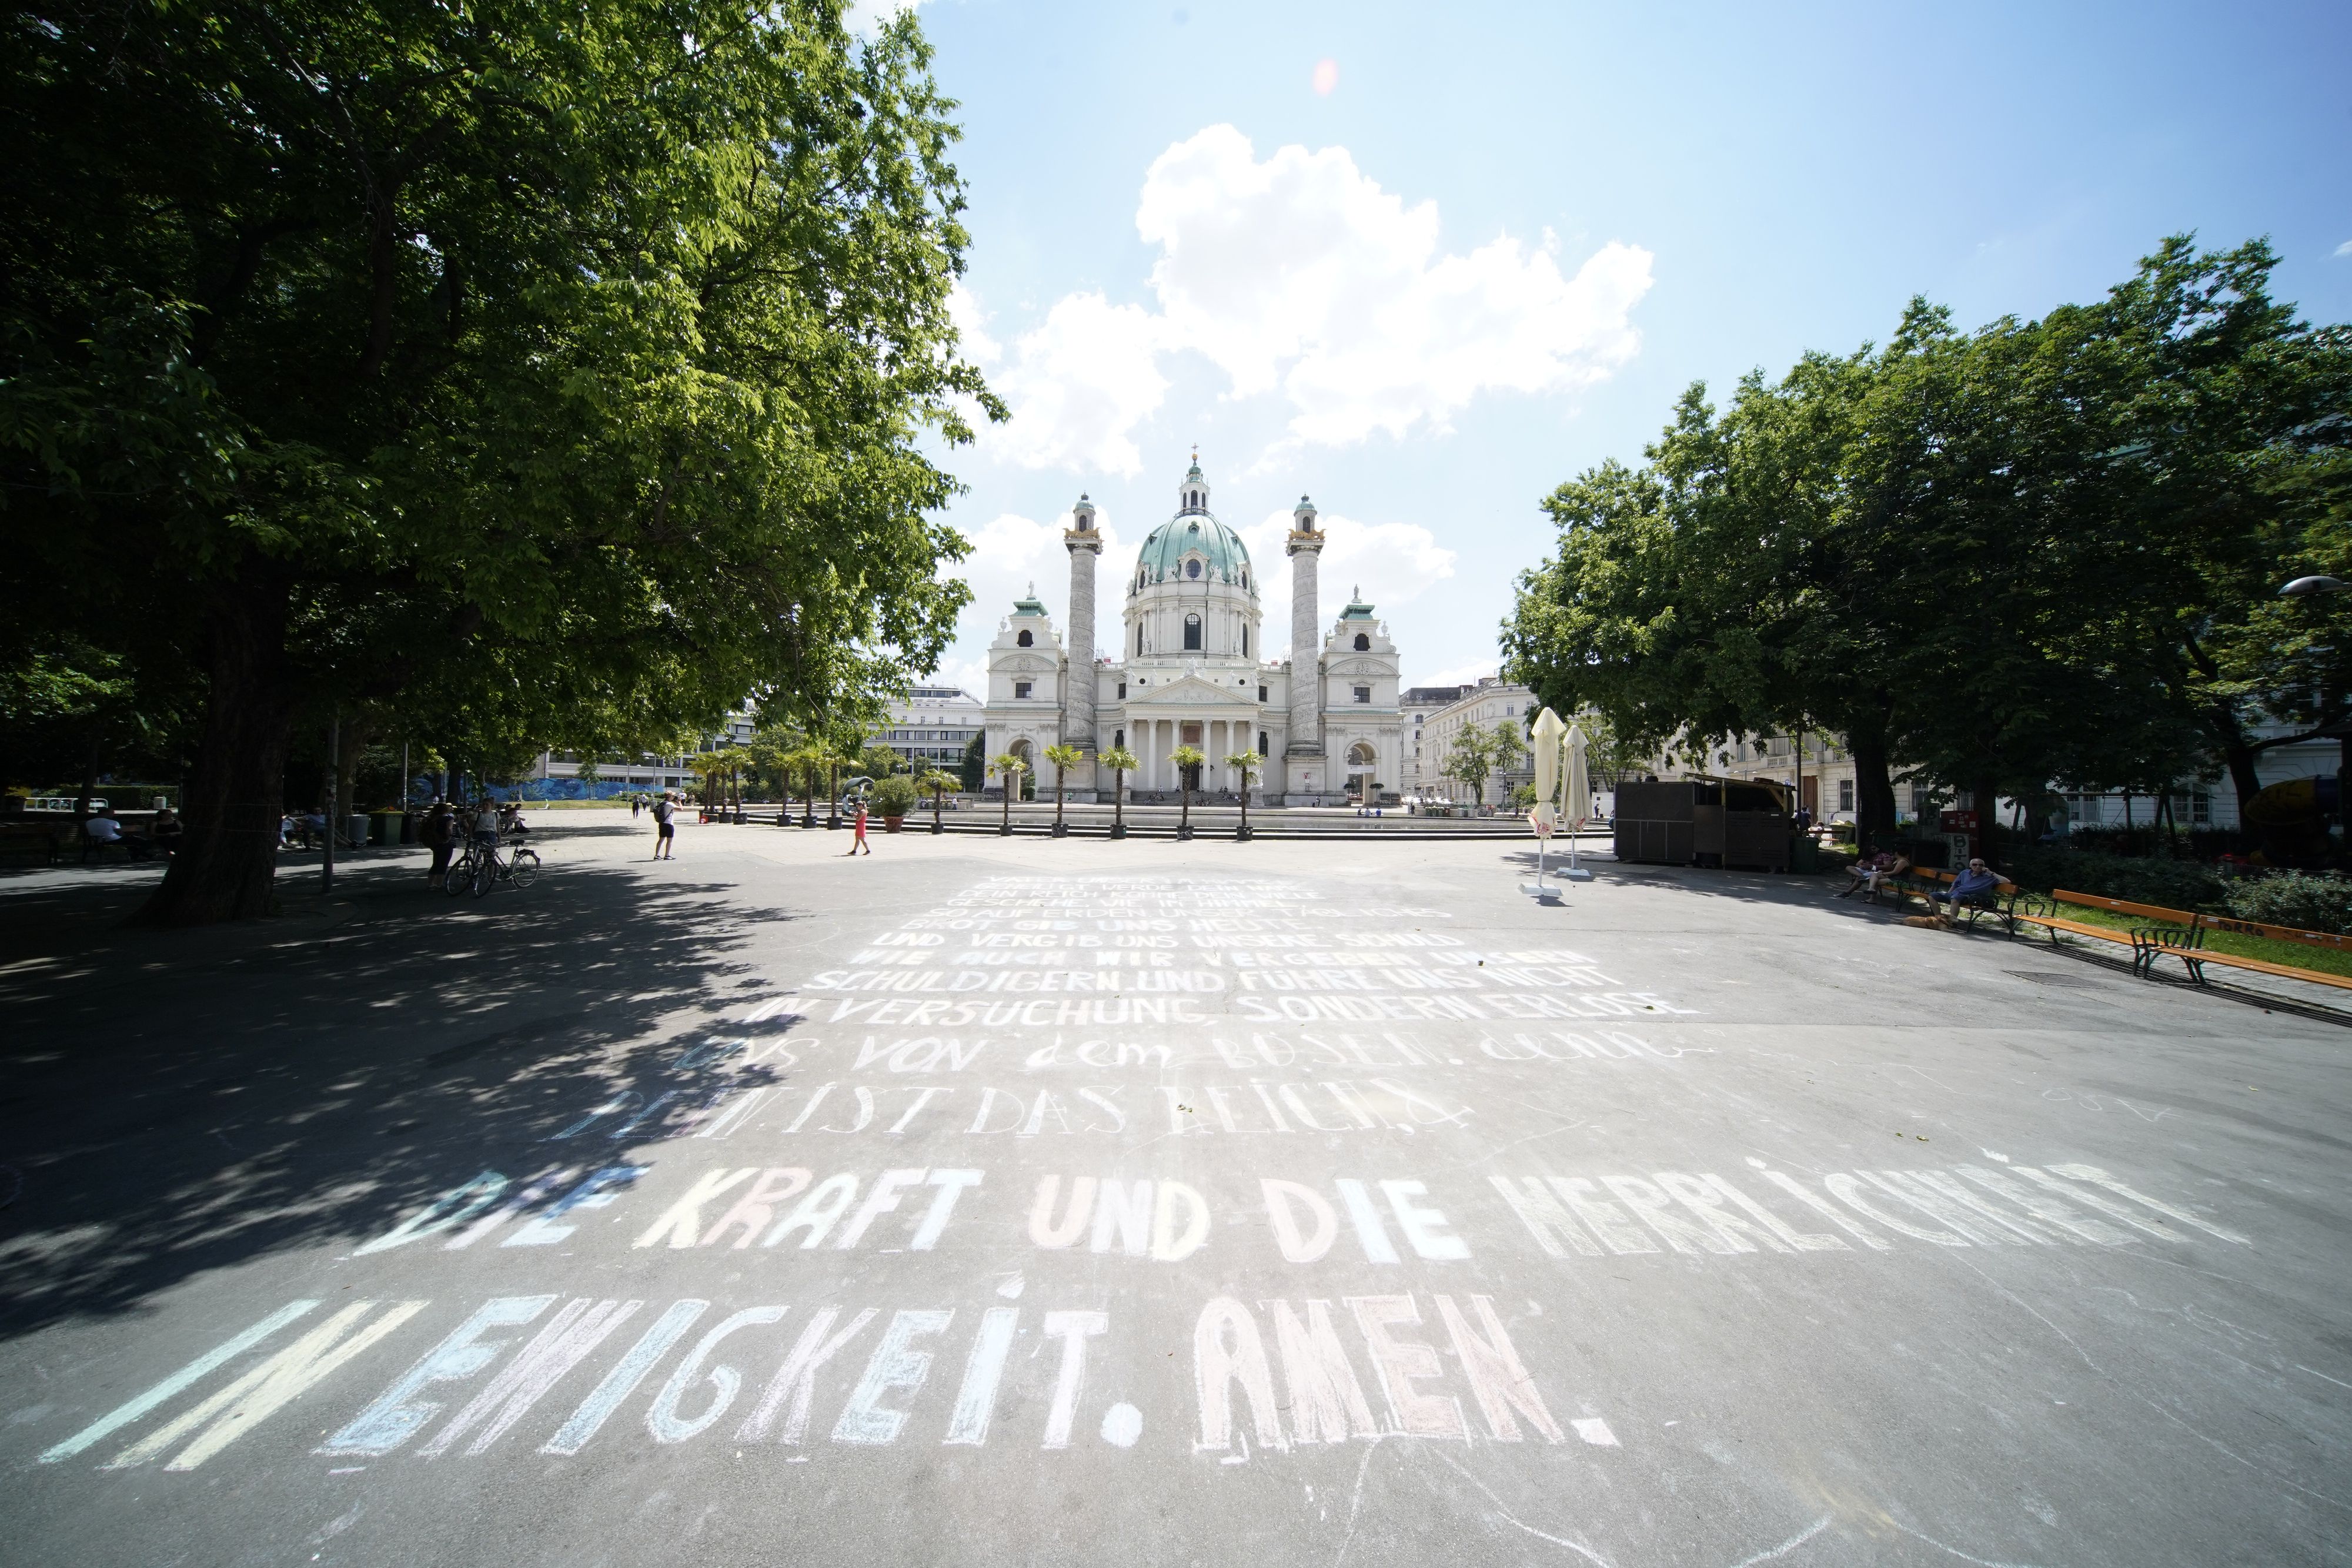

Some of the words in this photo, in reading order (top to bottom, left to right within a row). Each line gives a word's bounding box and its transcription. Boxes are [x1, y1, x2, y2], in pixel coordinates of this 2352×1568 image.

[947, 898, 1090, 907] GESCHEHE,
[1100, 899, 1142, 907] WIE
[1110, 891, 1187, 899] KOMME
[922, 908, 969, 917] SO
[970, 909, 1037, 918] AUF
[1159, 908, 1261, 917] UNSER
[900, 919, 1004, 930] BROT
[1013, 920, 1080, 931] GIB
[1097, 920, 1178, 931] UNS
[868, 932, 945, 947] UND
[971, 933, 1103, 947] VERGIB
[1117, 935, 1179, 948] UNS
[1192, 934, 1332, 948] UNSERE
[1335, 934, 1465, 947] SCHULD
[847, 950, 935, 965] WIE
[945, 951, 1069, 965] AUCH
[1095, 951, 1176, 967] WIR
[1197, 950, 1422, 967] VERGEBEN
[1428, 950, 1601, 966] UNSERN
[1137, 970, 1226, 992] UND
[1238, 969, 1387, 991] FÜHRE
[1378, 968, 1485, 988] UNS
[1476, 965, 1625, 988] NICHT
[743, 998, 823, 1024] IN
[828, 998, 1219, 1027] VERSUCHUNG,
[1236, 995, 1492, 1023] SONDERN
[1477, 992, 1711, 1019] ERLÖSE
[672, 1035, 822, 1072] UNS
[851, 1036, 991, 1074] VON
[1022, 1033, 1183, 1071] dem
[1479, 1028, 1720, 1061] denn
[536, 1081, 794, 1142] DEIN
[963, 1085, 1126, 1137] DAS
[353, 1167, 653, 1257] DIE
[630, 1167, 988, 1251] KRAFT
[1028, 1174, 1211, 1262] UND
[1258, 1178, 1472, 1265] DIE
[37, 1296, 434, 1472] IN
[1191, 1292, 1621, 1463] AMEN.
